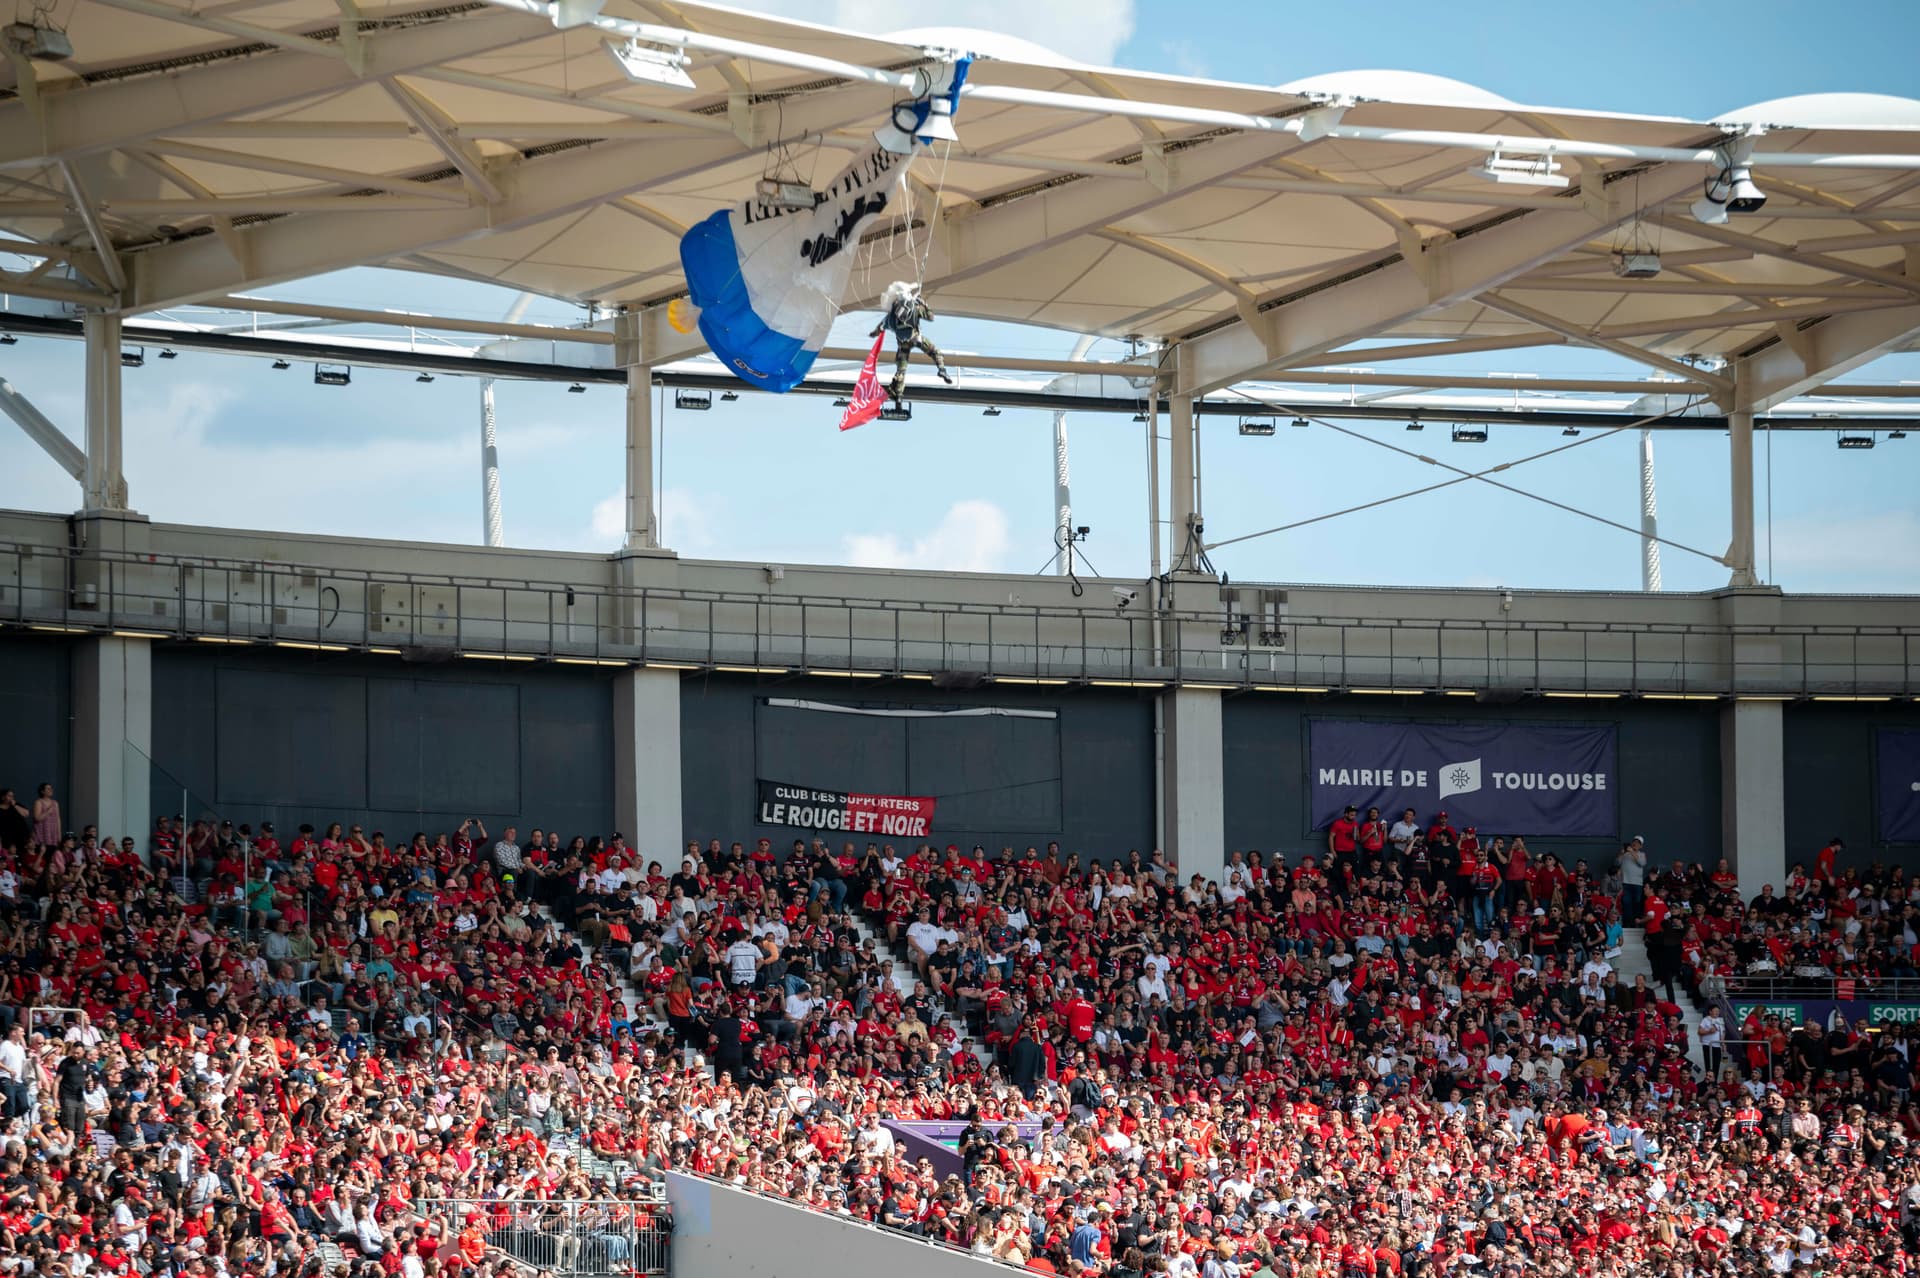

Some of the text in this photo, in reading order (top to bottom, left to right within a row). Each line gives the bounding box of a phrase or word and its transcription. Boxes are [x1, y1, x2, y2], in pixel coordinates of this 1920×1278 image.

[1319, 768, 1606, 790] MAIRIE DE TOULOUSE
[775, 787, 920, 811] CLUB DES SUPPORTERS
[762, 802, 926, 836] LE ROUGE ET NOIR
[1739, 1007, 1796, 1021] STIE
